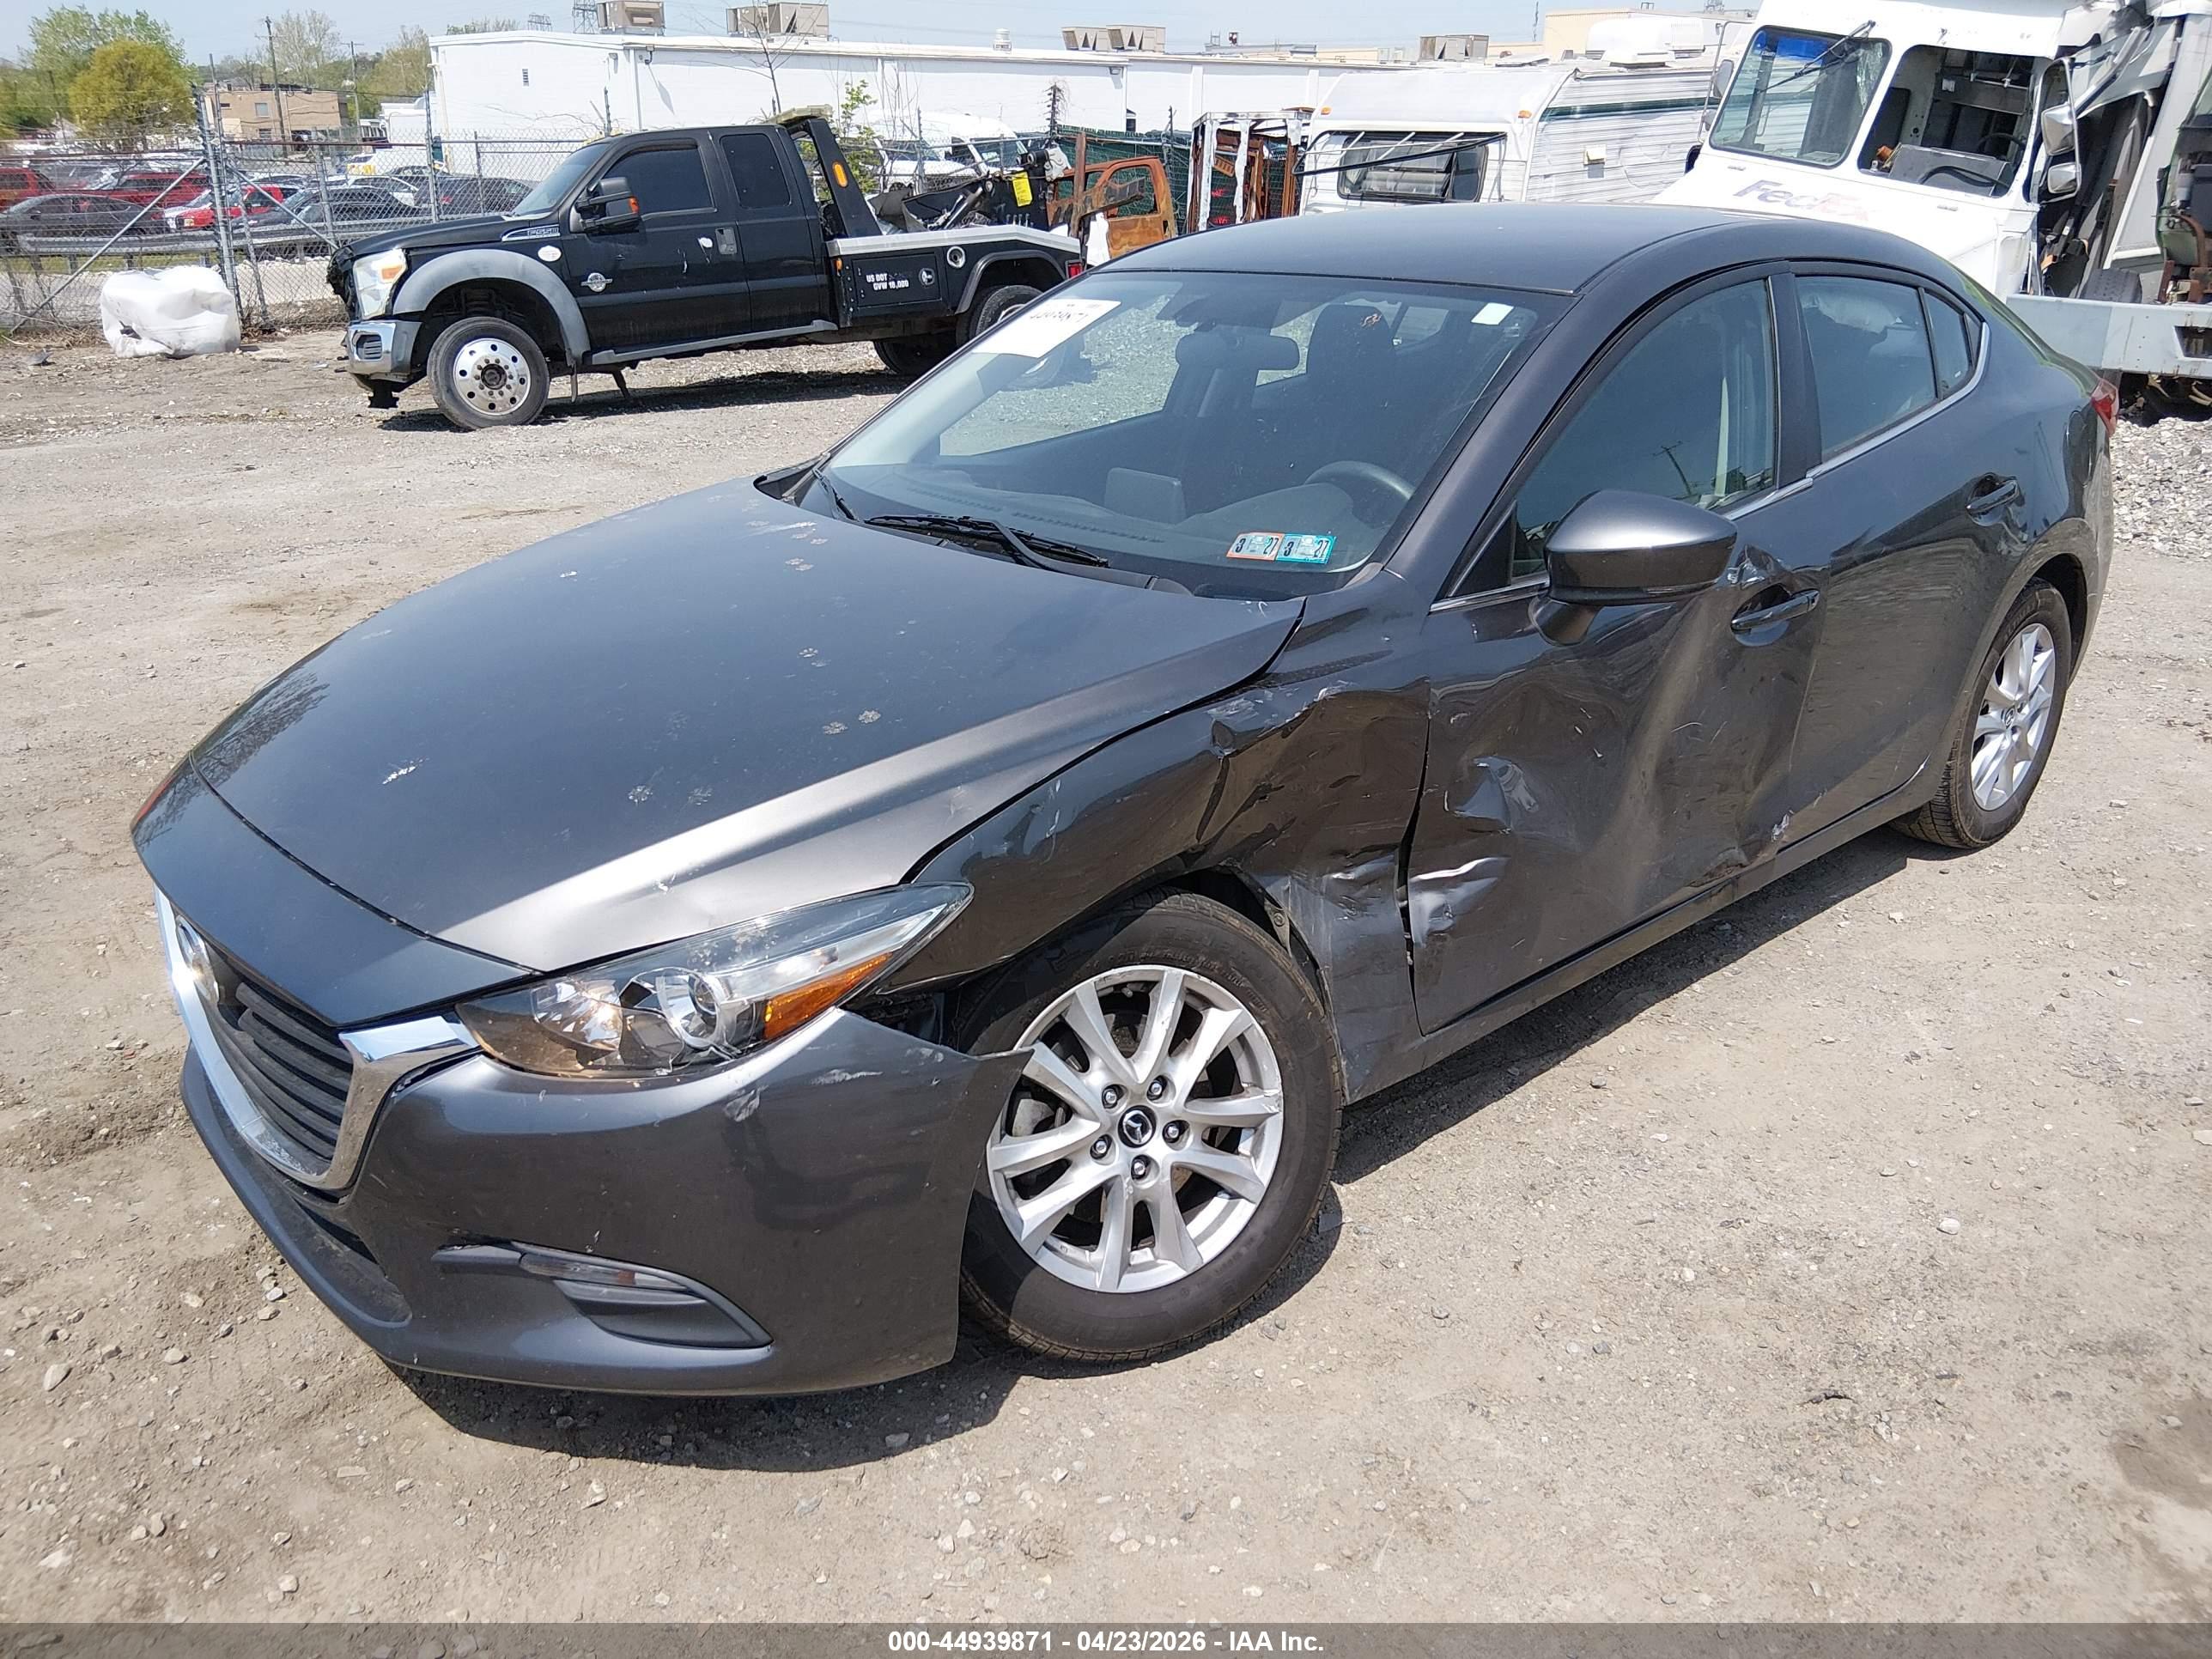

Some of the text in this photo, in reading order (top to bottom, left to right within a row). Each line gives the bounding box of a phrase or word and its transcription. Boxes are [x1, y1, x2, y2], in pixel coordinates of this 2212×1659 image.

[866, 274, 875, 283] US
[876, 273, 888, 282] DOT
[873, 282, 887, 290] GVW
[1235, 538, 1279, 555] 3 27
[1284, 540, 1329, 558] 3 27
